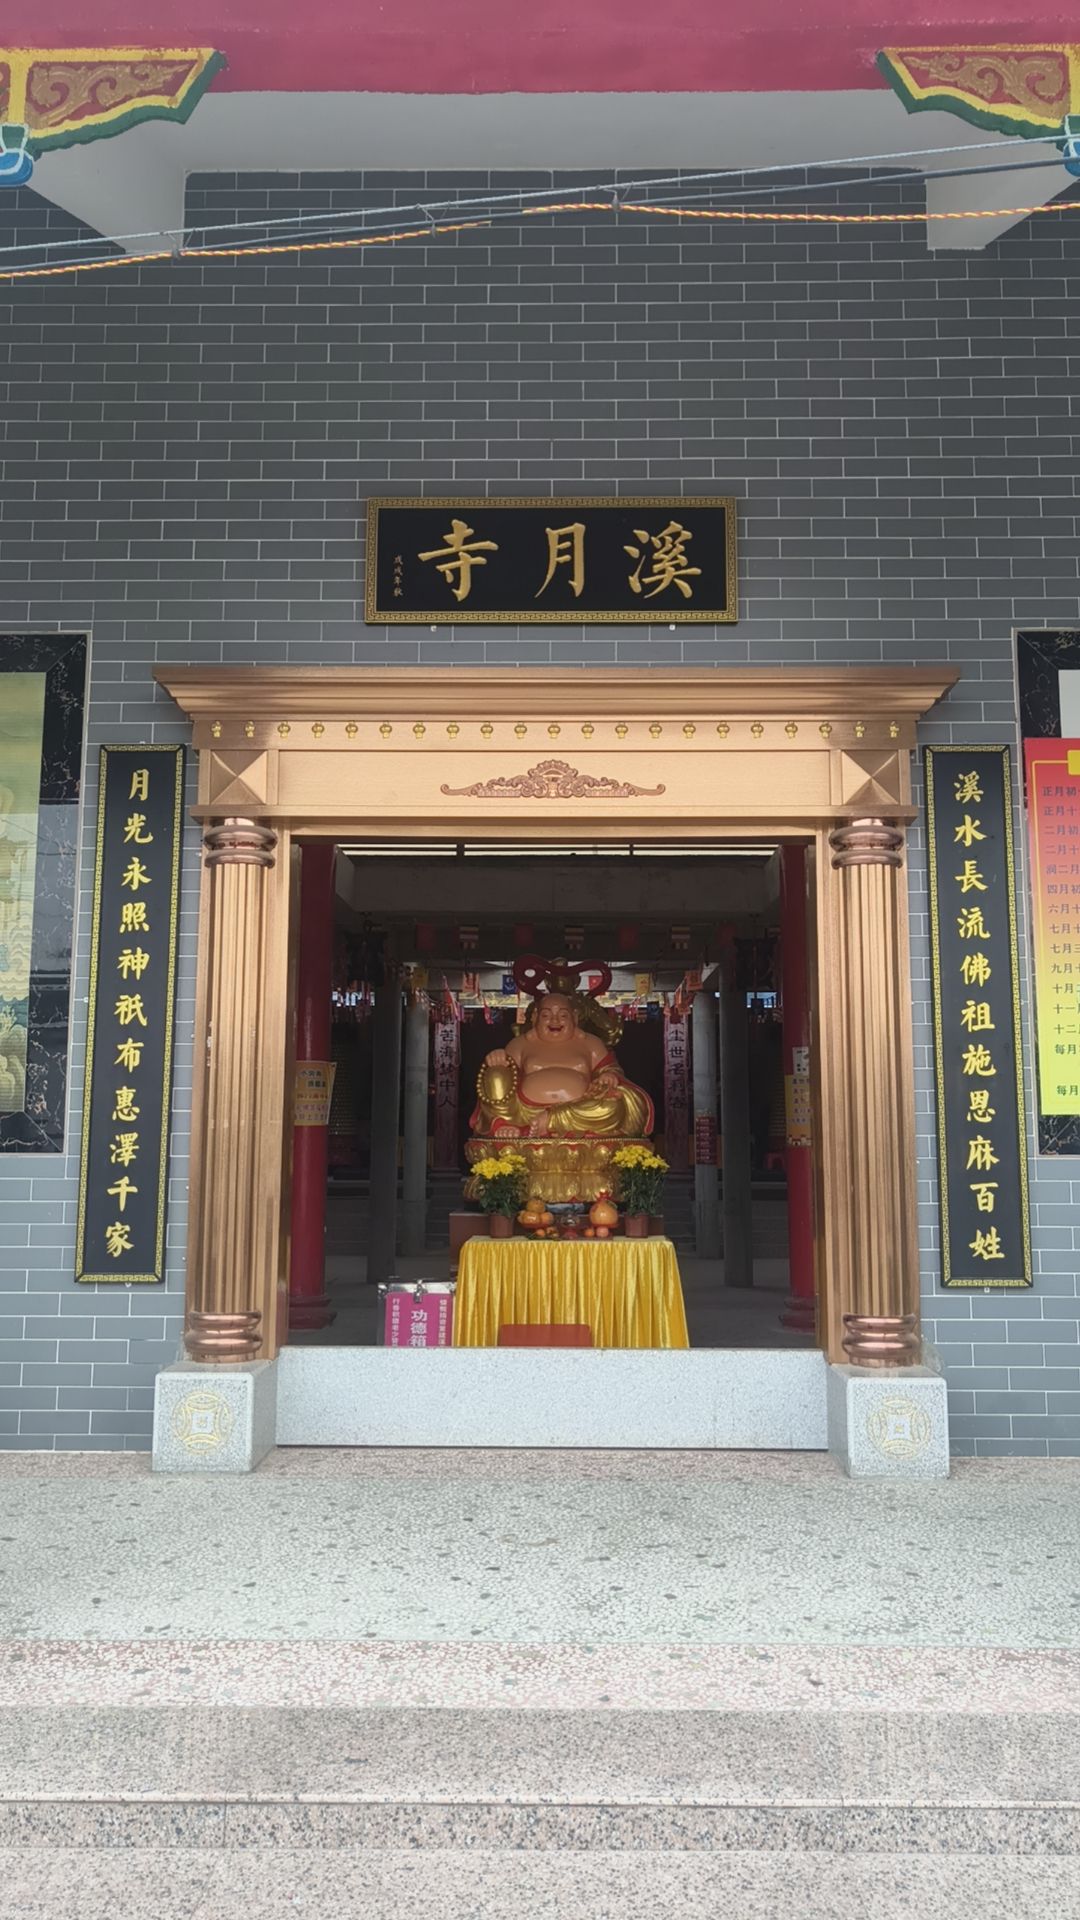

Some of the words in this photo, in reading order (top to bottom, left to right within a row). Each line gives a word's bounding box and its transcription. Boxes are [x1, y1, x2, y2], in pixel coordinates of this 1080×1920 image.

[417, 519, 702, 602] 溪月寺
[1043, 785, 1080, 797] 正月初
[1052, 1003, 1080, 1014] 十一
[1053, 1023, 1080, 1035] 十二
[1055, 1043, 1080, 1055] 每月
[410, 1309, 428, 1347] 功德箱
